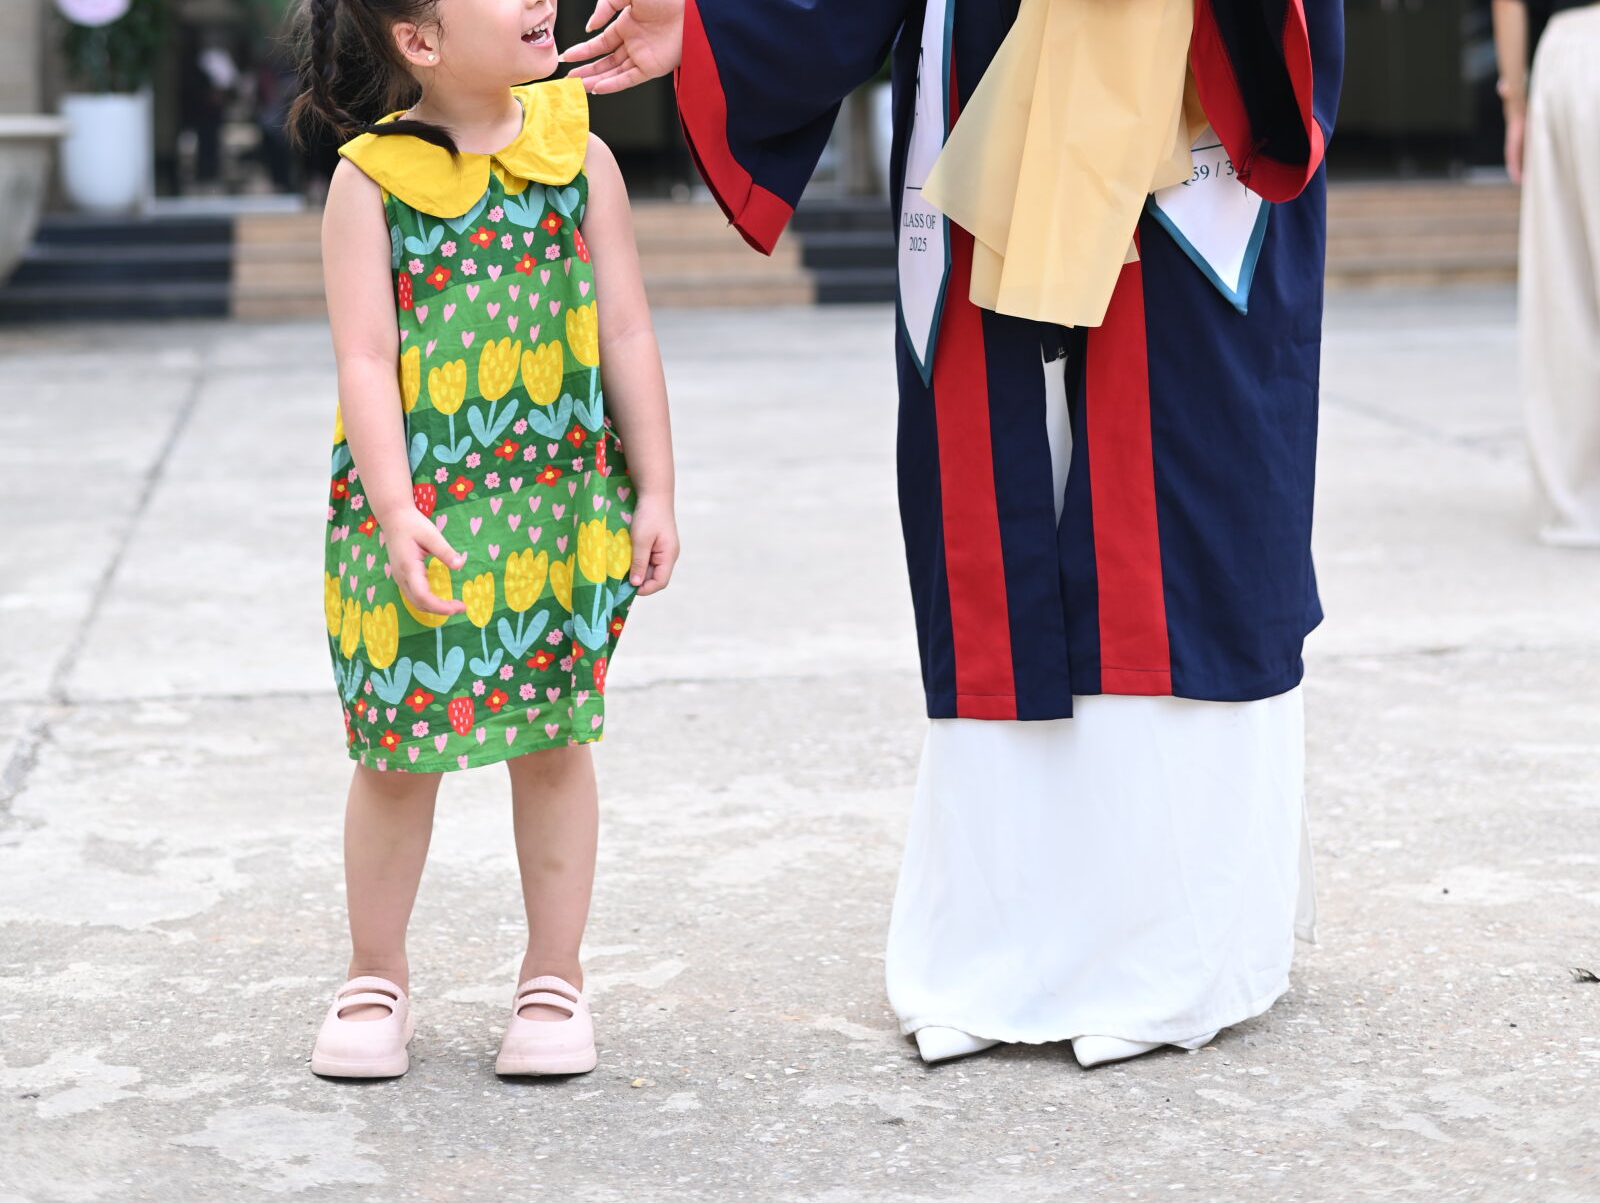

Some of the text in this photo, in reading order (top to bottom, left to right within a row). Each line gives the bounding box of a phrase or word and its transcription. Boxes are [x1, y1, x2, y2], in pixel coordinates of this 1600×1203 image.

[1225, 160, 1235, 176] 3
[902, 212, 936, 230] CLASS OF
[909, 236, 927, 252] 2025
